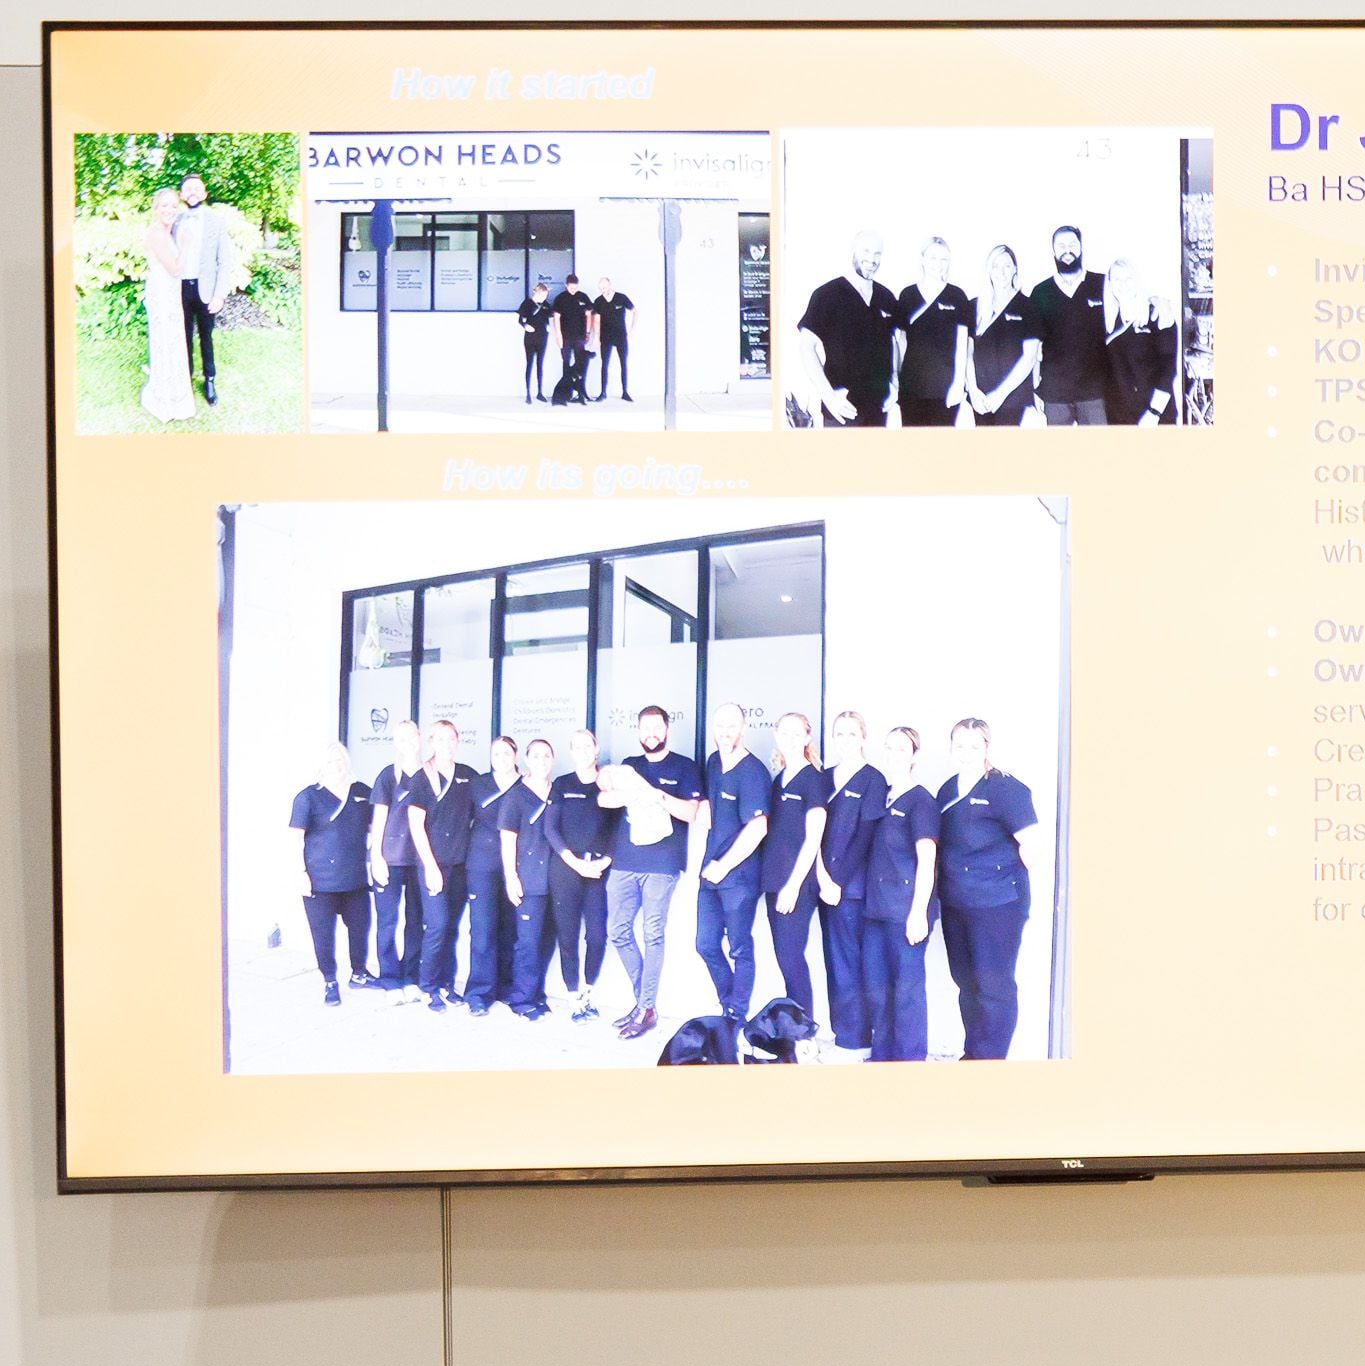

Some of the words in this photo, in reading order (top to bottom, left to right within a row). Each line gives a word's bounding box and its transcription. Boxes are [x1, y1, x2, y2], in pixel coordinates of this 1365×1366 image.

[391, 67, 475, 100] How
[484, 66, 513, 100] it
[520, 66, 656, 100] started
[1269, 102, 1340, 151] Dr
[457, 143, 562, 168] HEADS
[374, 176, 488, 190] DENTAL
[1268, 176, 1308, 202] Ba
[1322, 176, 1365, 201] HS
[443, 458, 527, 491] How
[536, 457, 585, 491] its
[1313, 897, 1351, 921] for
[1061, 1159, 1084, 1168] TCL
